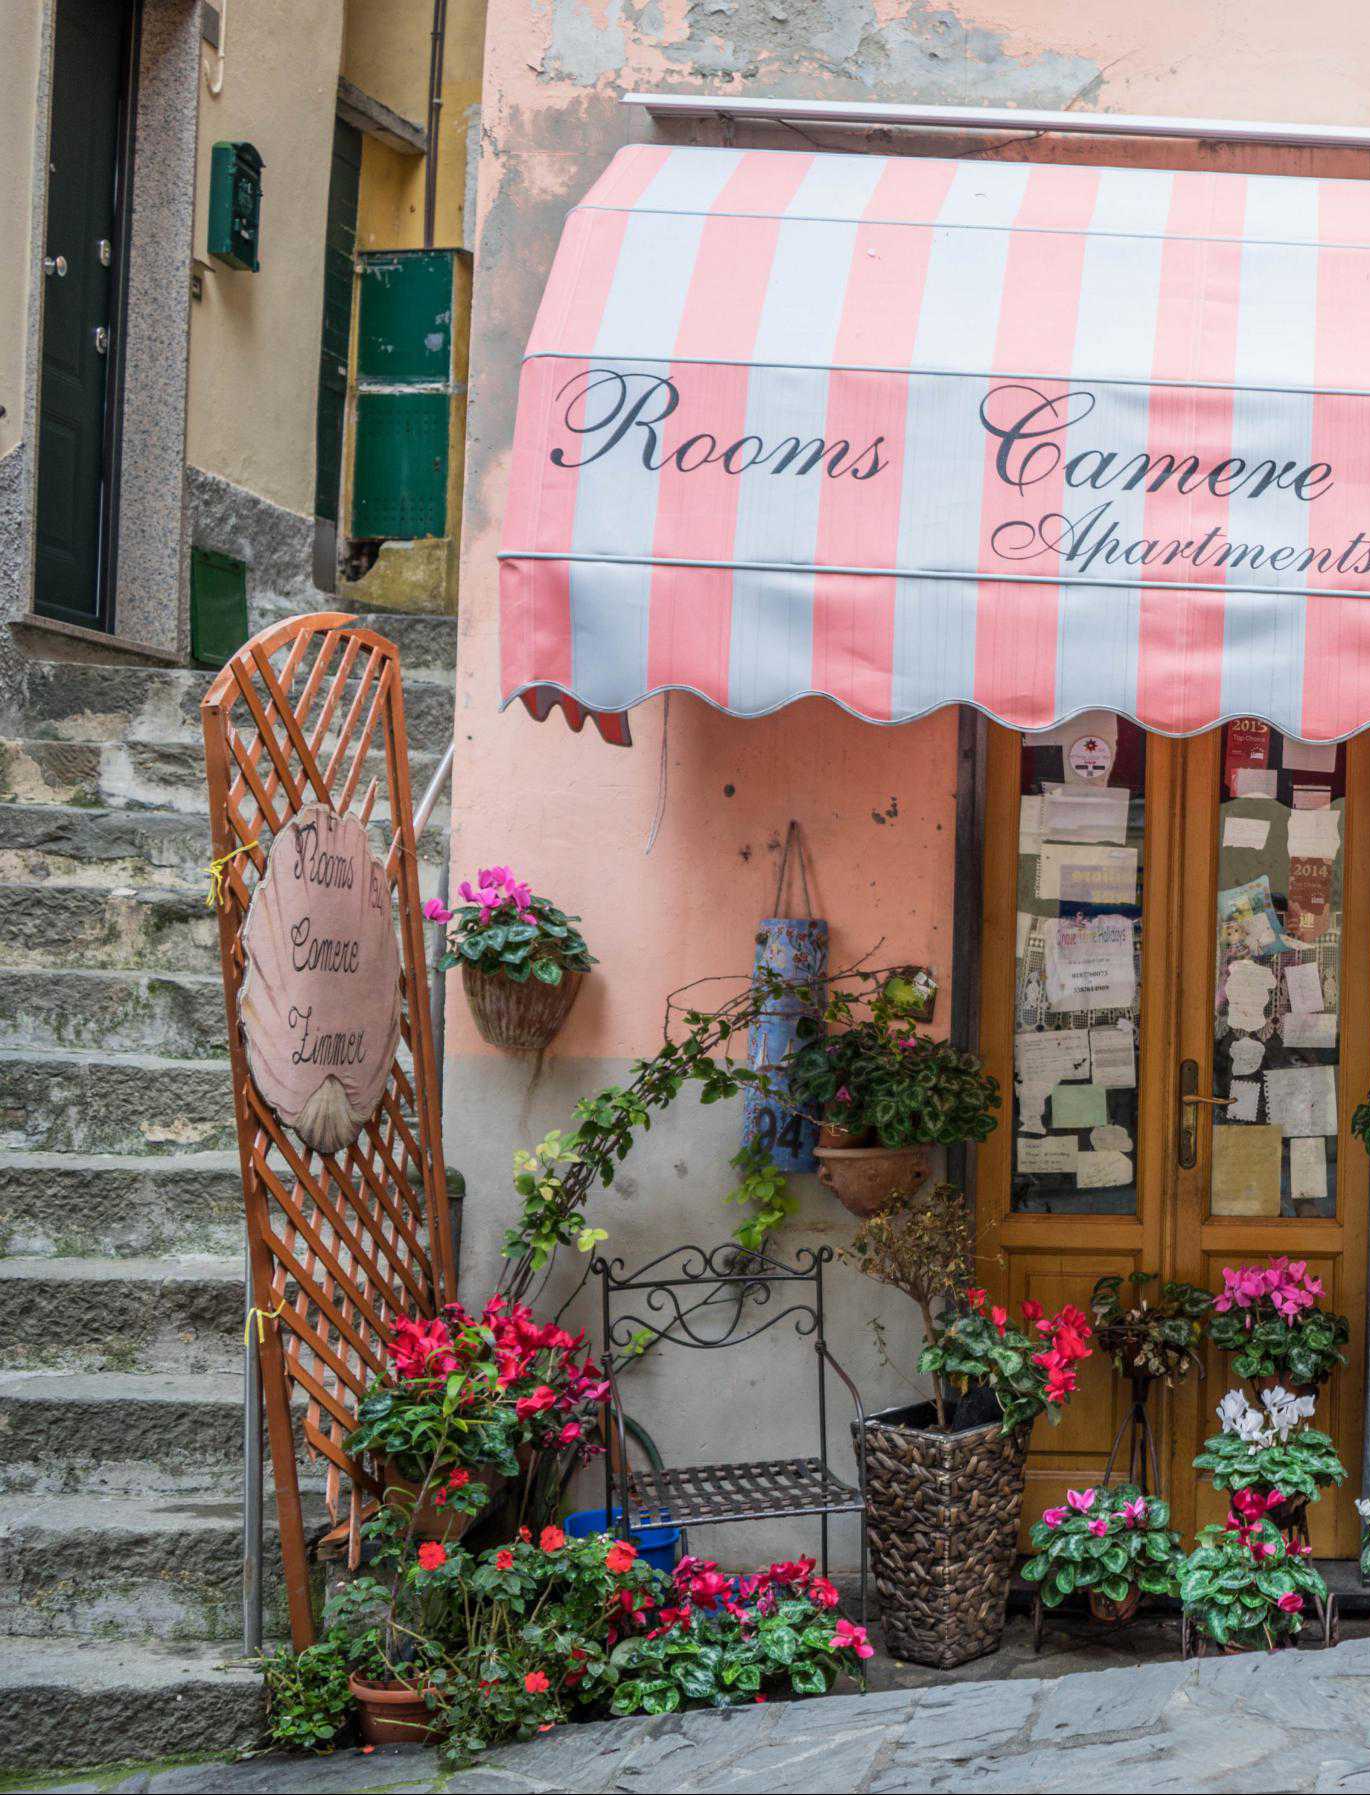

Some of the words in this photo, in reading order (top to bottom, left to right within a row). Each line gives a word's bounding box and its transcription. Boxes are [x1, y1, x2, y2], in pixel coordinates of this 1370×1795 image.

[550, 368, 889, 480] Rooms
[979, 384, 1334, 500] Camere
[294, 820, 355, 889] Rooms
[1295, 864, 1329, 878] 2014
[288, 1005, 367, 1066] Zimmer
[754, 1107, 805, 1158] 94
